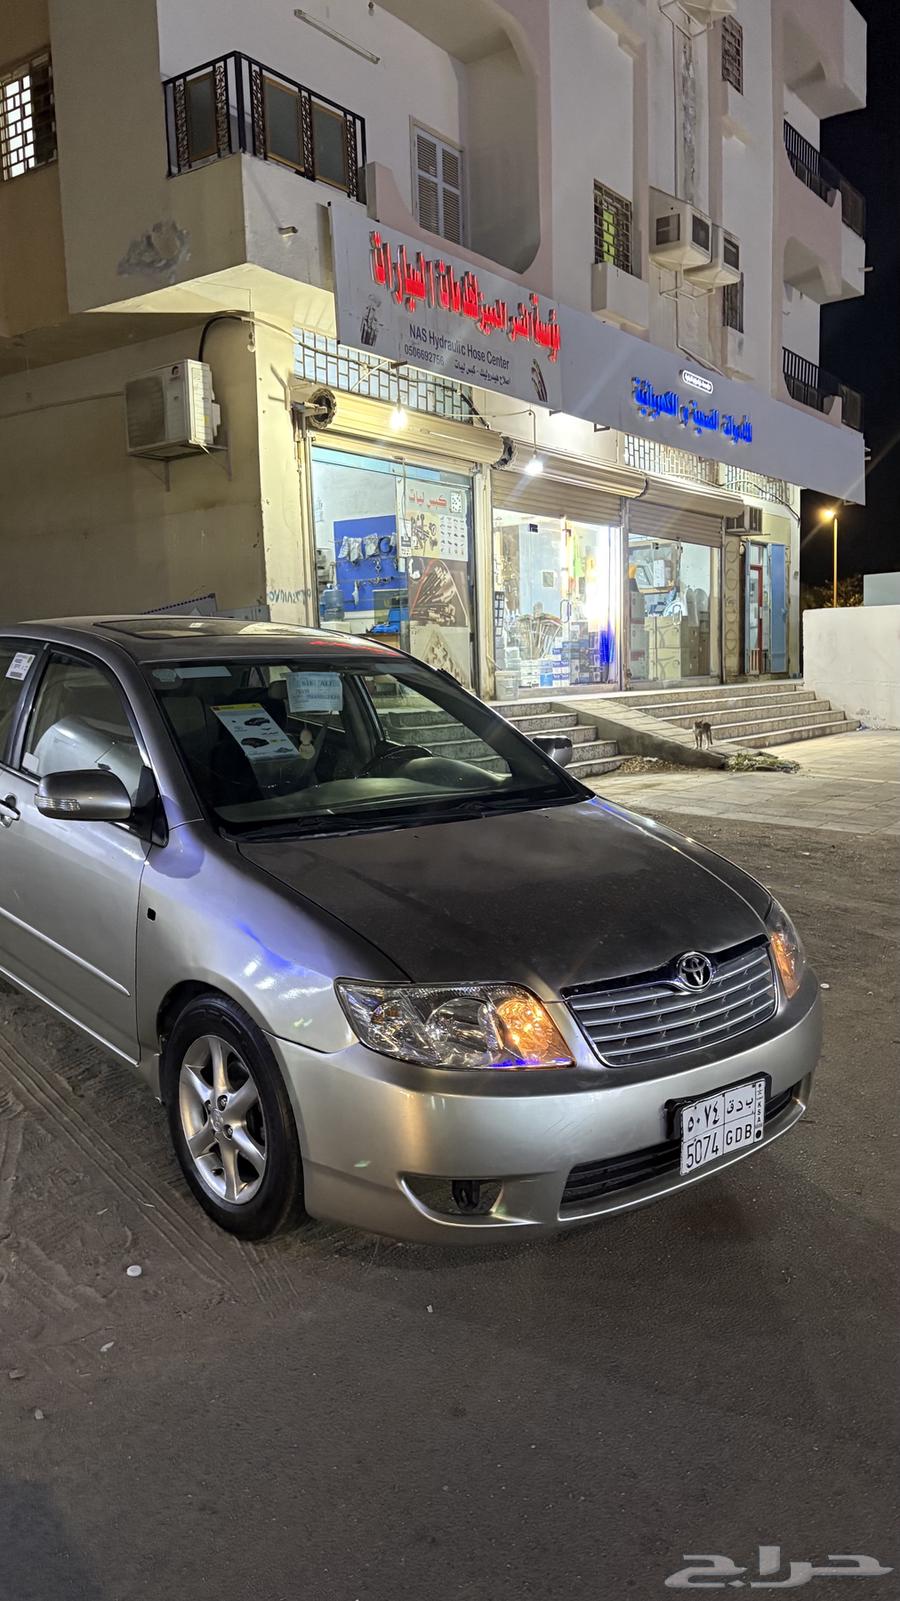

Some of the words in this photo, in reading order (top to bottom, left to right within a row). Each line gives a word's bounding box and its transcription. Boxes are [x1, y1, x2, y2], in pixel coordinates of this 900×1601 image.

[370, 231, 436, 313] السيارات
[409, 324, 427, 344] NAS
[467, 343, 486, 361] Hose
[487, 350, 510, 370] Center
[687, 1100, 720, 1132] ٥٠٧٤
[686, 1131, 719, 1168] 5074
[726, 1123, 752, 1146] GDB
